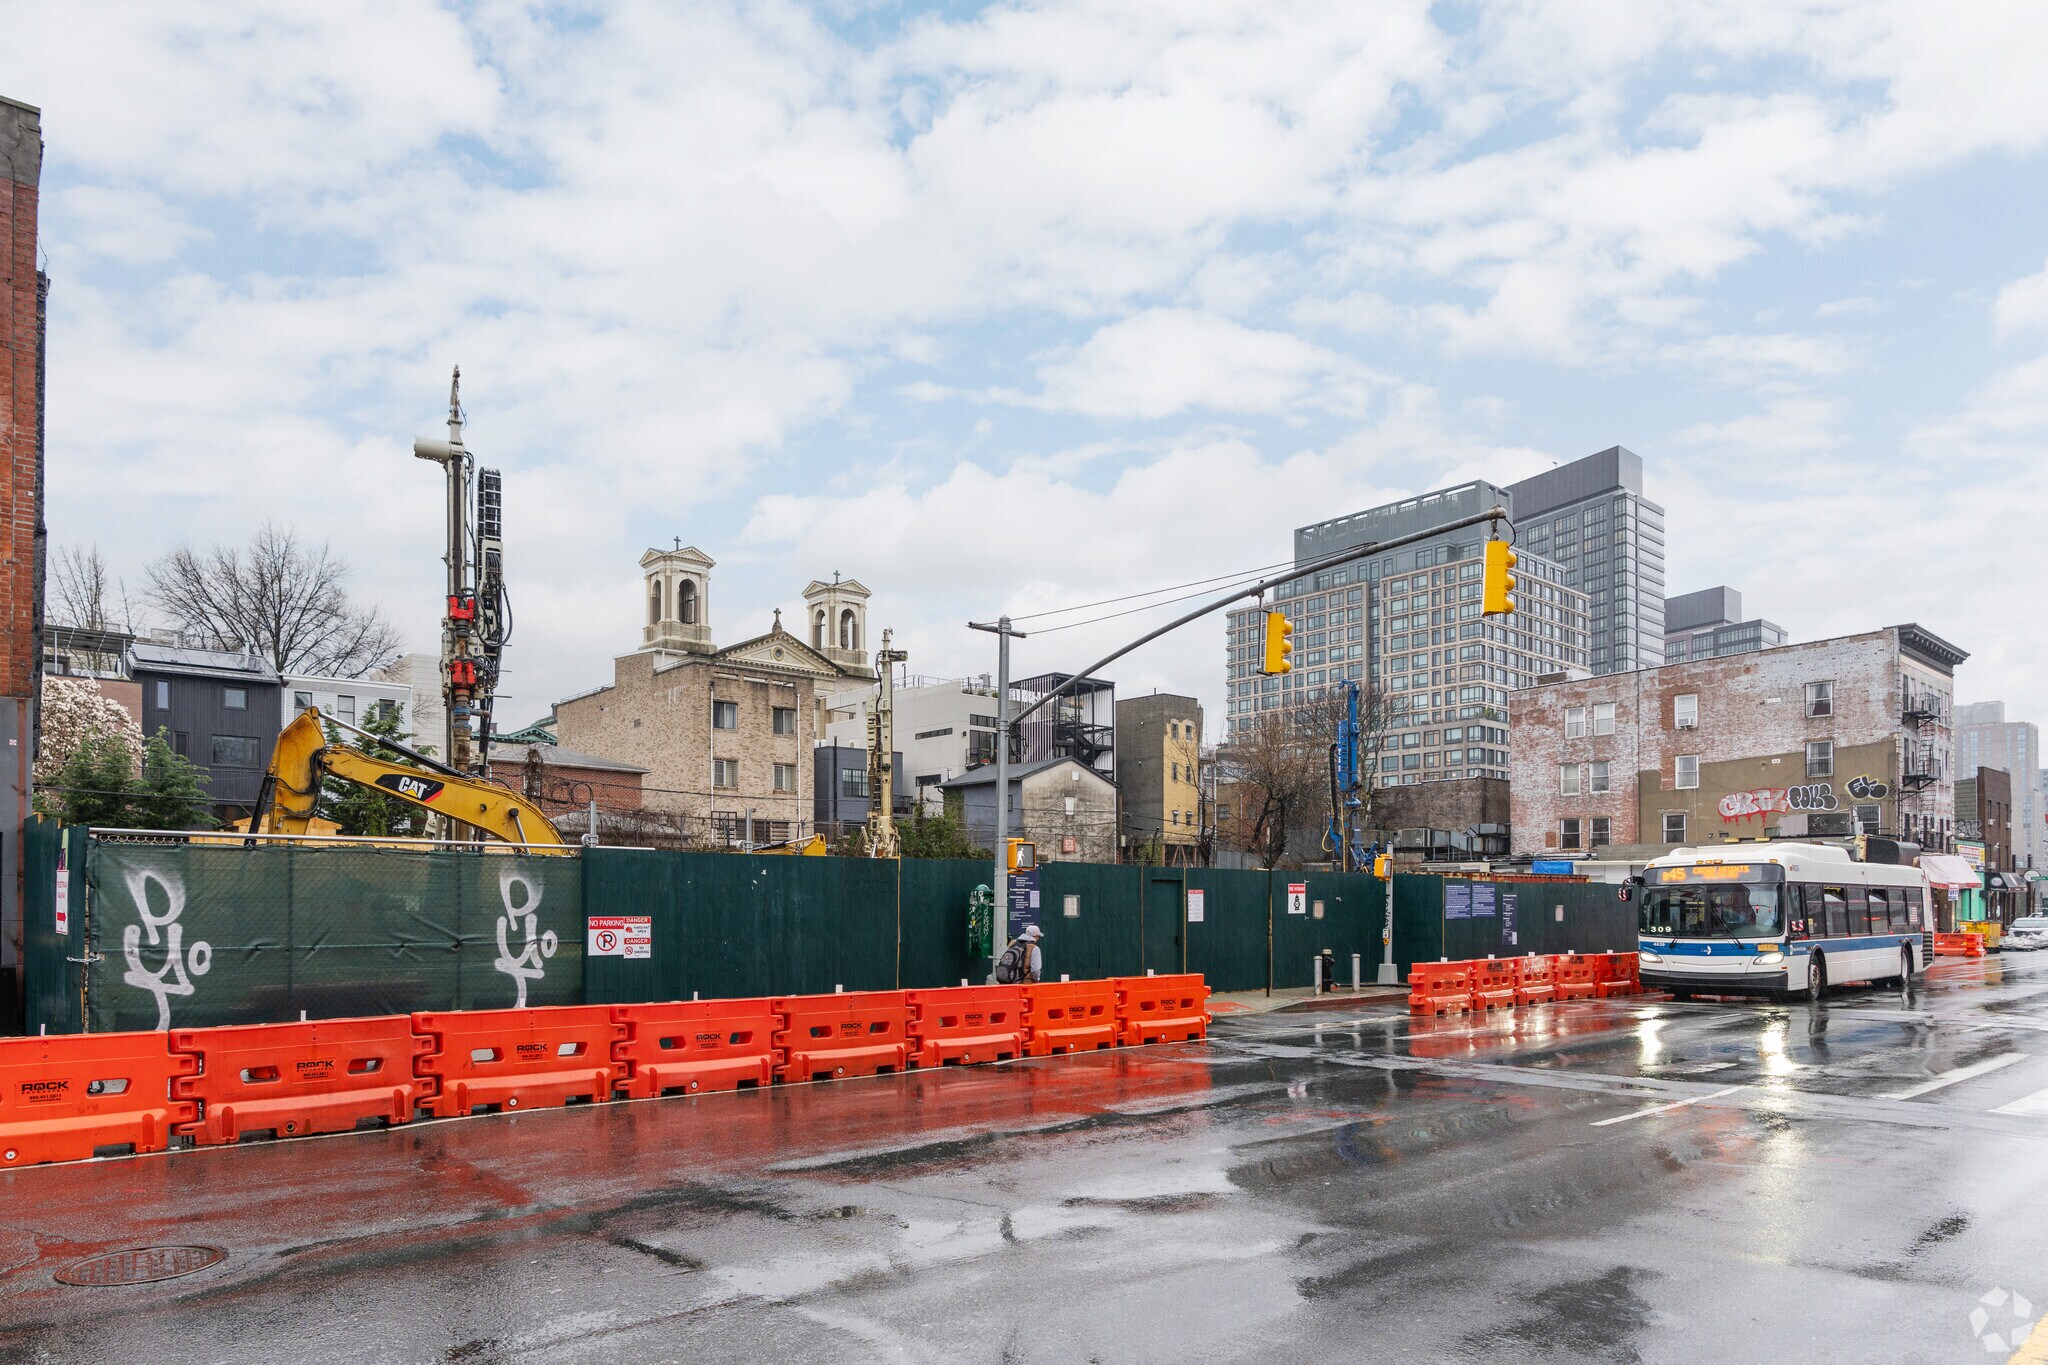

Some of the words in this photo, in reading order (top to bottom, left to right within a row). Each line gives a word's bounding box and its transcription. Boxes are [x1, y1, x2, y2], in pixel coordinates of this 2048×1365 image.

[398, 776, 428, 799] CAT
[590, 919, 599, 927] NO
[600, 919, 624, 927] PARKING
[1650, 925, 1672, 933] 309
[696, 1033, 722, 1041] ROCK
[517, 1043, 548, 1052] ROCK
[22, 1081, 69, 1092] ROCK
